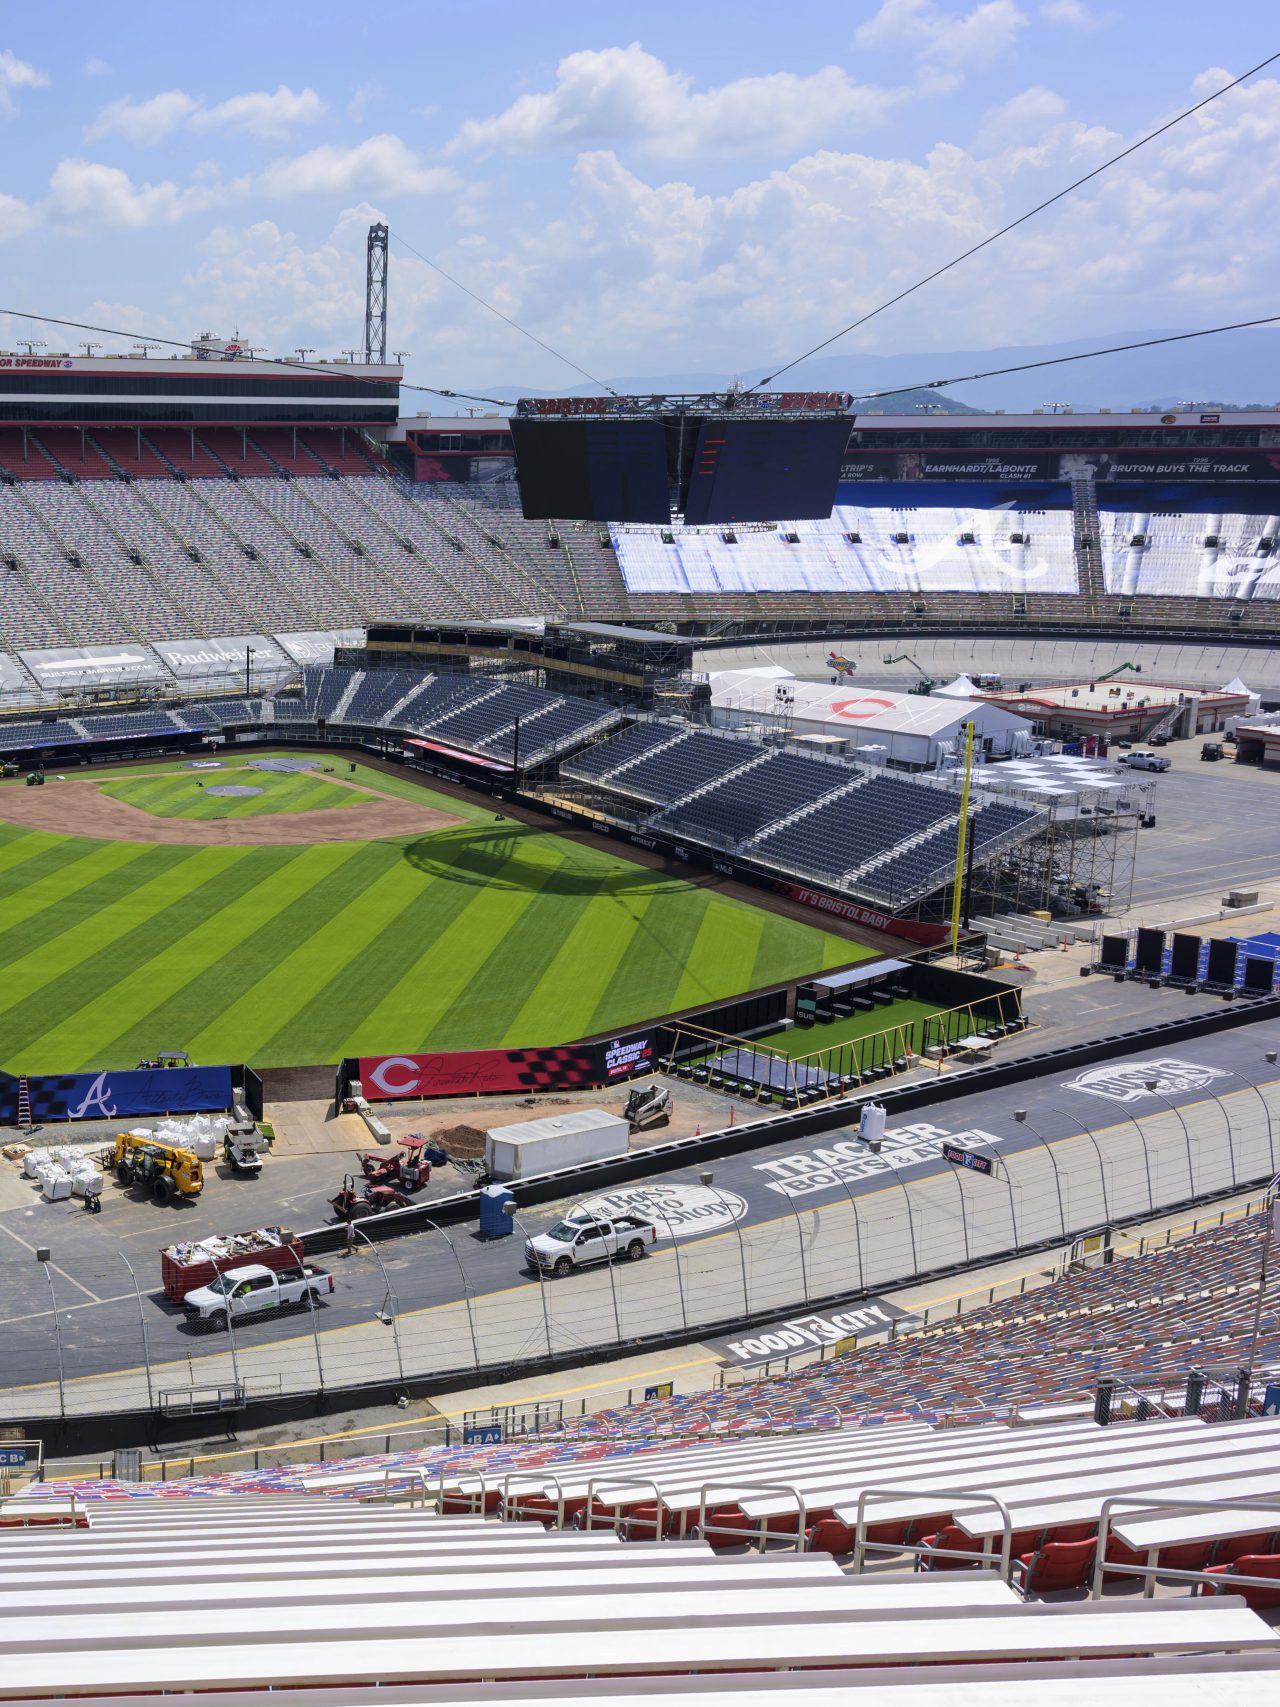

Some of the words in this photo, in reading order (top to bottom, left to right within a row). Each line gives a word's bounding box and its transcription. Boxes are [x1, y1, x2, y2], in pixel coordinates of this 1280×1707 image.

[15, 359, 62, 369] SPEEDWAY
[925, 464, 1038, 474] EARNHARDT/LABONTE
[1109, 464, 1154, 473] BRUTON
[1156, 464, 1185, 473] BUYS
[1189, 464, 1209, 473] THE
[1212, 464, 1250, 473] TRACK
[592, 821, 610, 833] GEICO
[720, 864, 733, 876] MLB
[798, 890, 819, 905] IT'S
[819, 896, 862, 921] BRISTOL
[861, 911, 892, 929] BABY
[605, 1040, 648, 1060] SPEEDWAY
[607, 1051, 641, 1068] CLASSIC
[1079, 1061, 1210, 1098] BUSH'S
[947, 1149, 964, 1162] FOOD
[973, 1158, 987, 1170] CITY
[784, 1156, 893, 1192] BOATS
[892, 1155, 915, 1165] &
[603, 1187, 676, 1210] Bass
[630, 1199, 685, 1218] Pro
[655, 1200, 741, 1226] Shops
[726, 1330, 805, 1360] FOOD
[831, 1305, 892, 1331] CITY
[474, 1434, 483, 1444] B
[484, 1433, 495, 1444] A
[0, 1454, 7, 1463] C
[9, 1454, 19, 1463] B
